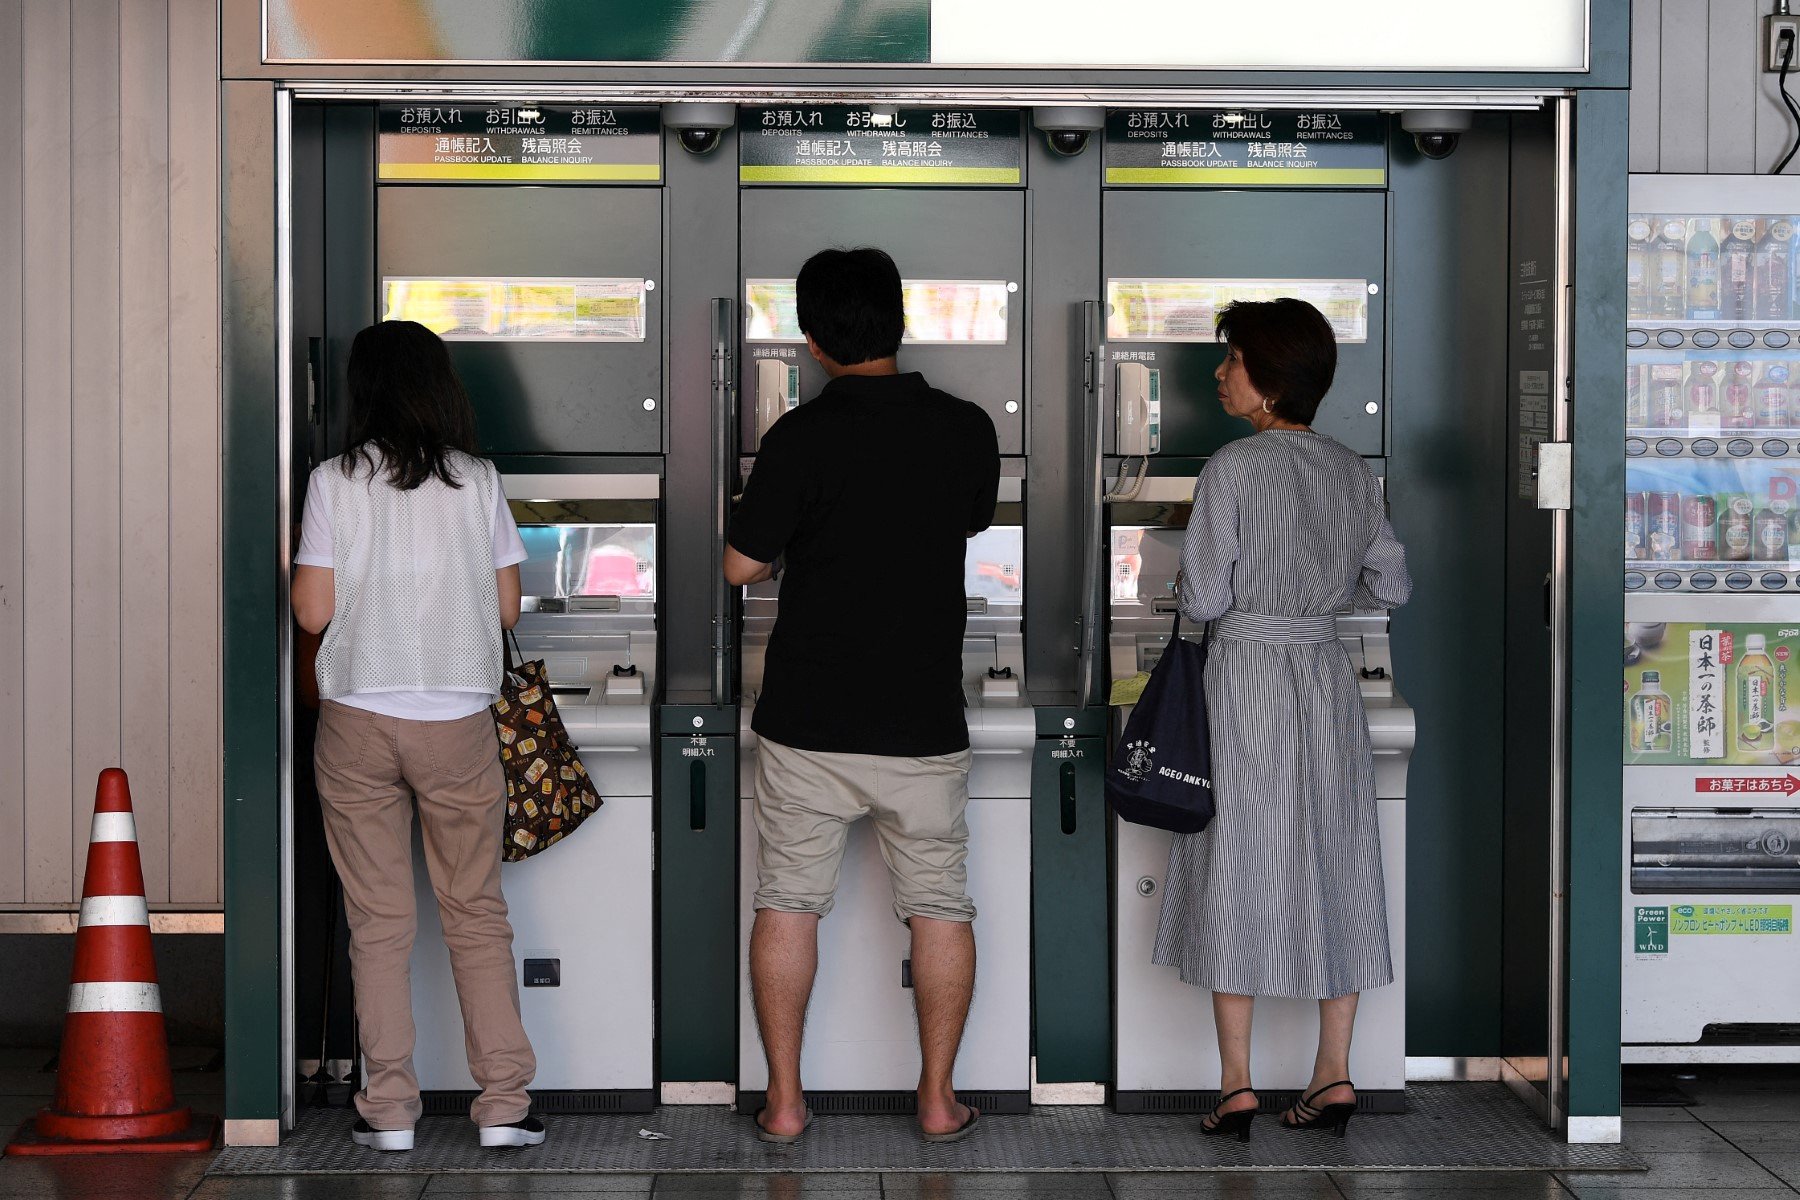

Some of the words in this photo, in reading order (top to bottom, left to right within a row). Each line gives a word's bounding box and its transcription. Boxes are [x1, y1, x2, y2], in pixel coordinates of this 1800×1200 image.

[400, 108, 462, 124] お預入れ
[572, 110, 616, 126] お振込
[762, 111, 824, 127] お預入れ
[846, 111, 906, 128] お引し
[932, 112, 976, 128] お振込
[1128, 113, 1189, 128] お預入れ
[1296, 114, 1342, 130] お振込
[846, 130, 906, 138] WITHDRAWALS
[1296, 132, 1354, 140] REMITTANCES
[434, 138, 496, 154] 通帳記入
[522, 138, 582, 154] 残高照会
[796, 140, 856, 156] 通帳記入
[882, 141, 942, 157] 残高照会
[1162, 142, 1222, 158] 通帳記入
[1248, 142, 1308, 158] 残高照会
[522, 156, 559, 164] BALANCE
[795, 158, 840, 166] PASSBOOK
[1206, 160, 1238, 168] UPDATE
[752, 348, 796, 358] 連絡用電話
[1112, 351, 1156, 360] 連絡用電話
[1696, 634, 1716, 737] 日本一の茶師
[690, 738, 707, 746] 不要
[1059, 740, 1076, 748] 不要
[682, 748, 715, 756] 明細入れ
[1052, 750, 1084, 758] 明細入れ
[1158, 766, 1182, 780] AGEO
[1709, 779, 1794, 792] お菓子はあちら
[1638, 908, 1664, 916] Green
